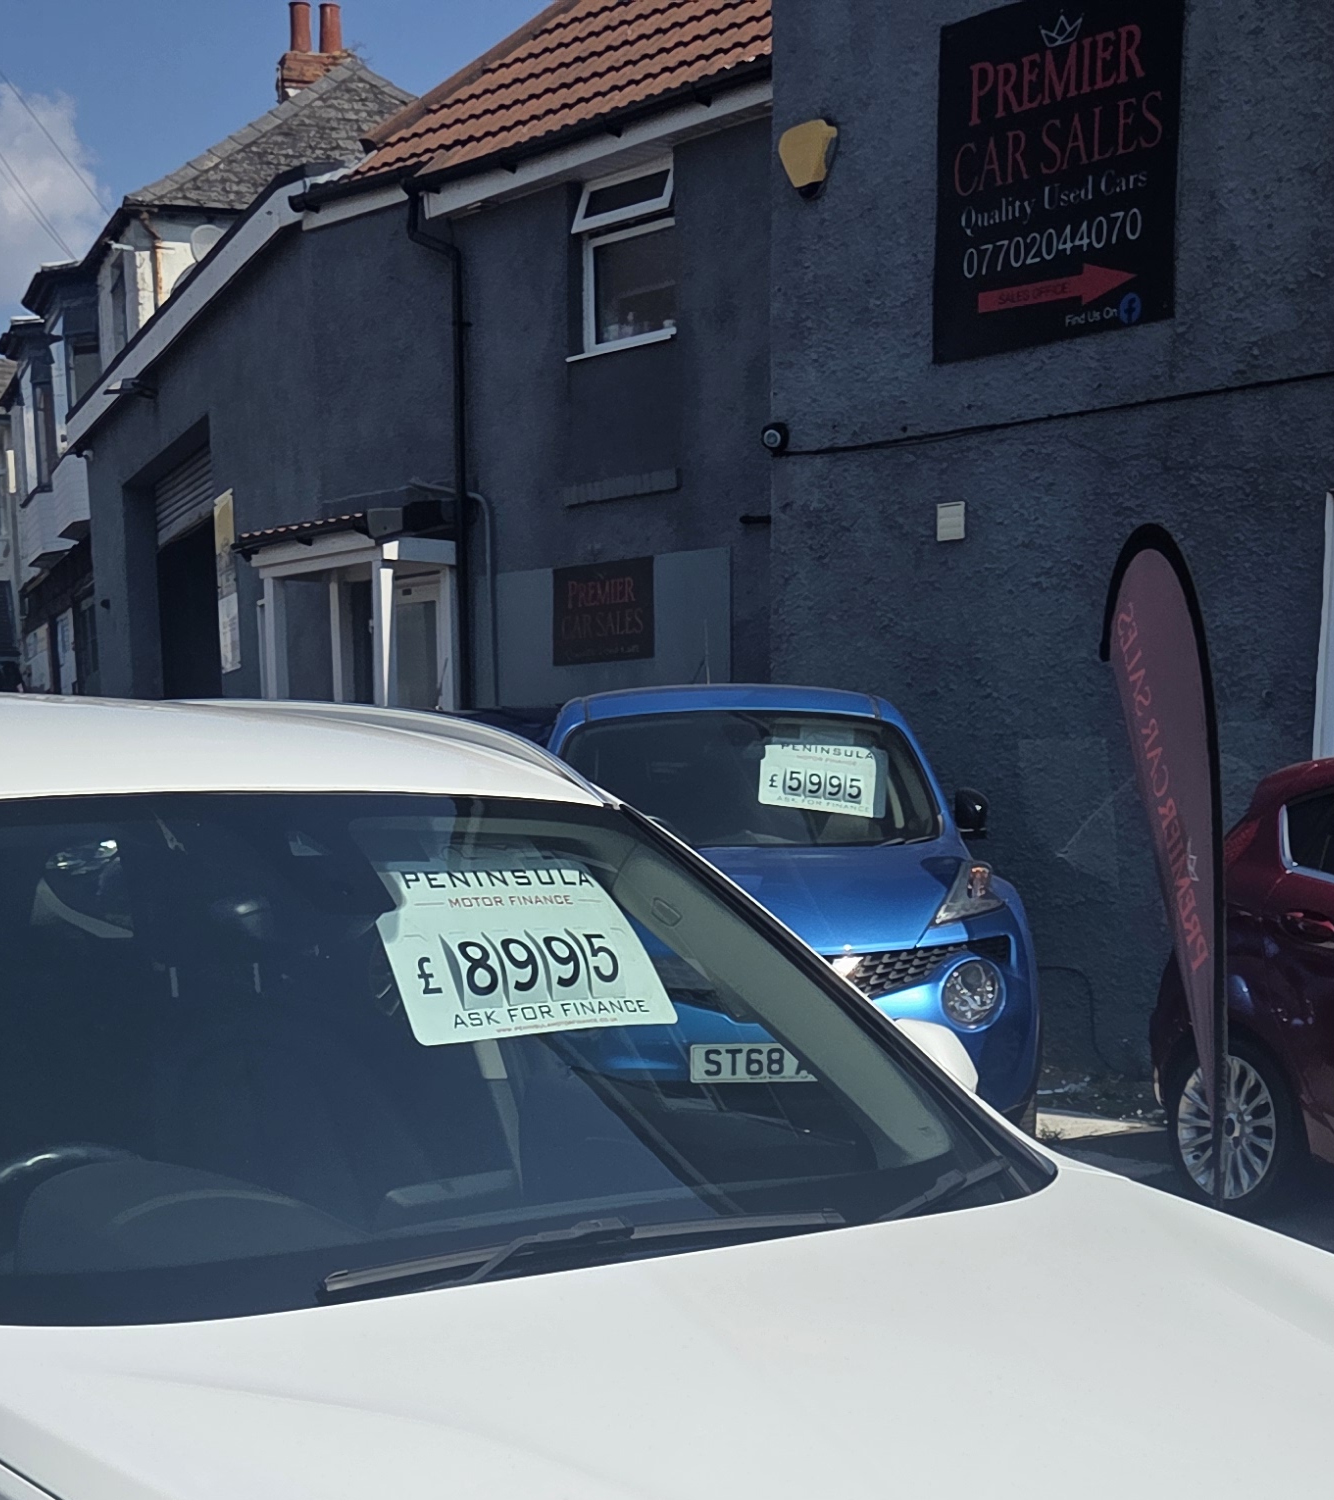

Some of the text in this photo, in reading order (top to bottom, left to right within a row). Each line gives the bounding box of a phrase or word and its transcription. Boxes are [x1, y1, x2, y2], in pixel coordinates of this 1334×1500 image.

[969, 24, 1146, 127] PREMIER
[954, 90, 1163, 197] CAR SALES
[961, 169, 1148, 237] Quality Used Cars
[963, 207, 1143, 279] 07702044070
[998, 282, 1070, 306] SALES OFFICE
[1065, 312, 1086, 327] Find
[1087, 310, 1101, 323] Us
[1104, 306, 1119, 320] On
[567, 577, 636, 609] PREMIER
[561, 607, 644, 641] CAR SALES
[780, 743, 874, 760] PENINSULA
[402, 869, 595, 890] PENINSULA
[447, 894, 574, 908] MOTOR FINANCE
[453, 999, 651, 1029] ASK FOR FINANCE
[703, 1048, 785, 1077] ST68
